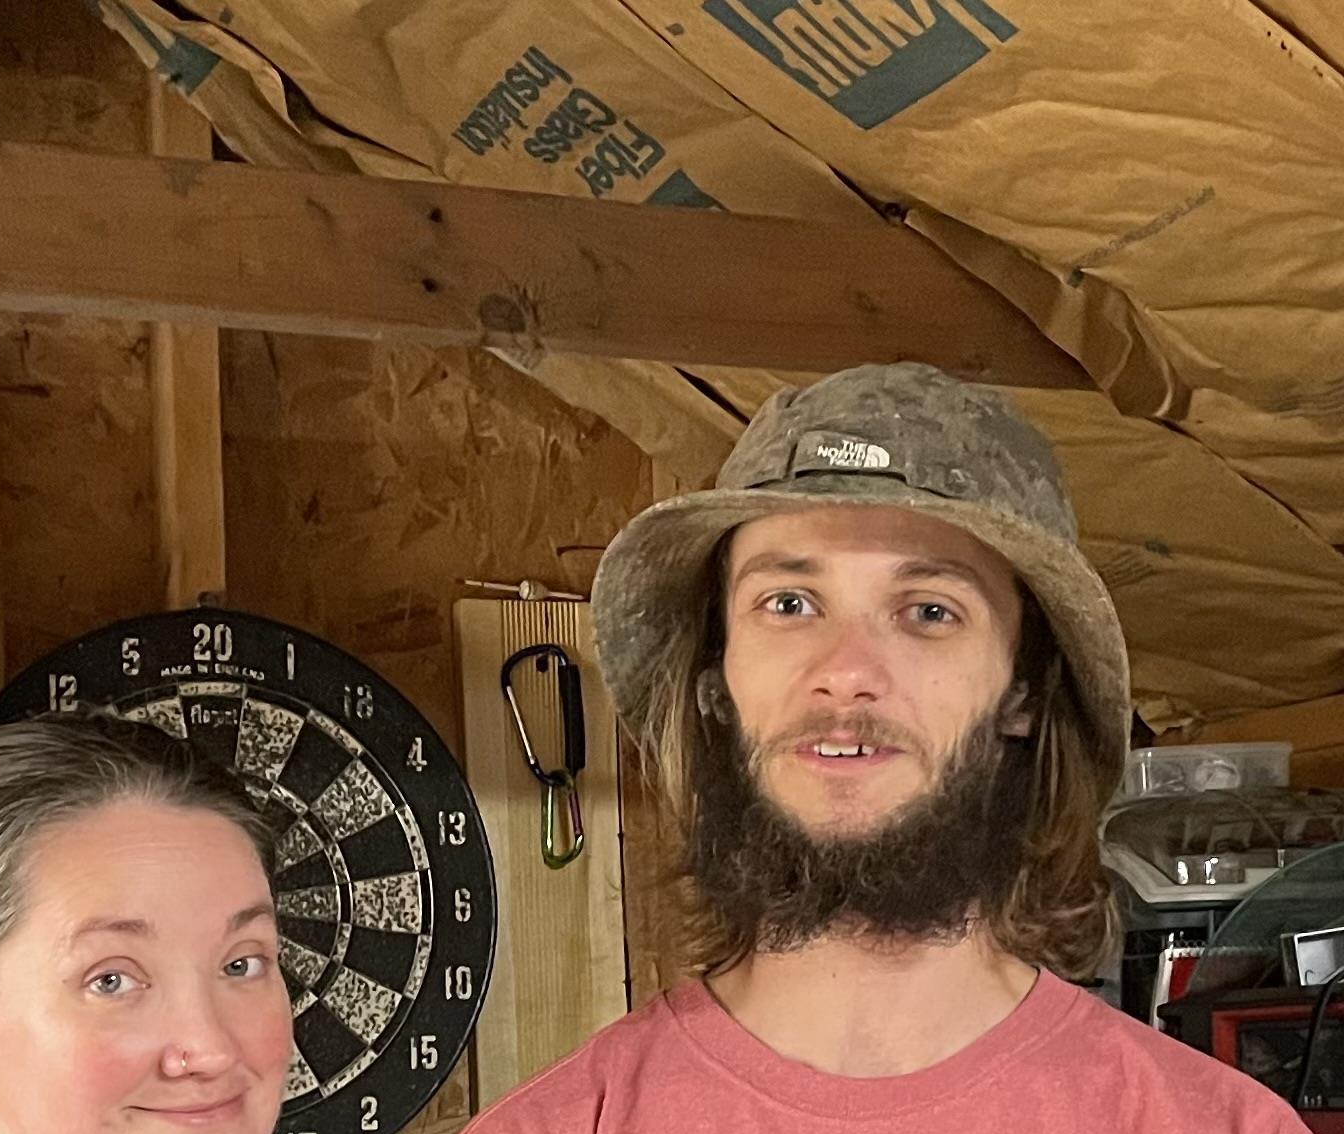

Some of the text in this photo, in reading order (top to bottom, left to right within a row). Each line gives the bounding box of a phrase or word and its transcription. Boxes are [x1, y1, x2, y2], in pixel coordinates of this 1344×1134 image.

[451, 46, 572, 155] Insulation
[524, 88, 617, 163] Glass
[575, 118, 667, 197] Fiber
[121, 638, 142, 676] 5
[193, 623, 233, 662] 20
[286, 642, 296, 680] 1
[48, 673, 78, 710] 12
[343, 684, 375, 720] 18
[406, 736, 428, 773] 4
[437, 812, 466, 846] 13
[454, 887, 472, 924] 6
[444, 966, 472, 999] 10
[409, 1036, 438, 1070] 15
[361, 1096, 378, 1130] 2
